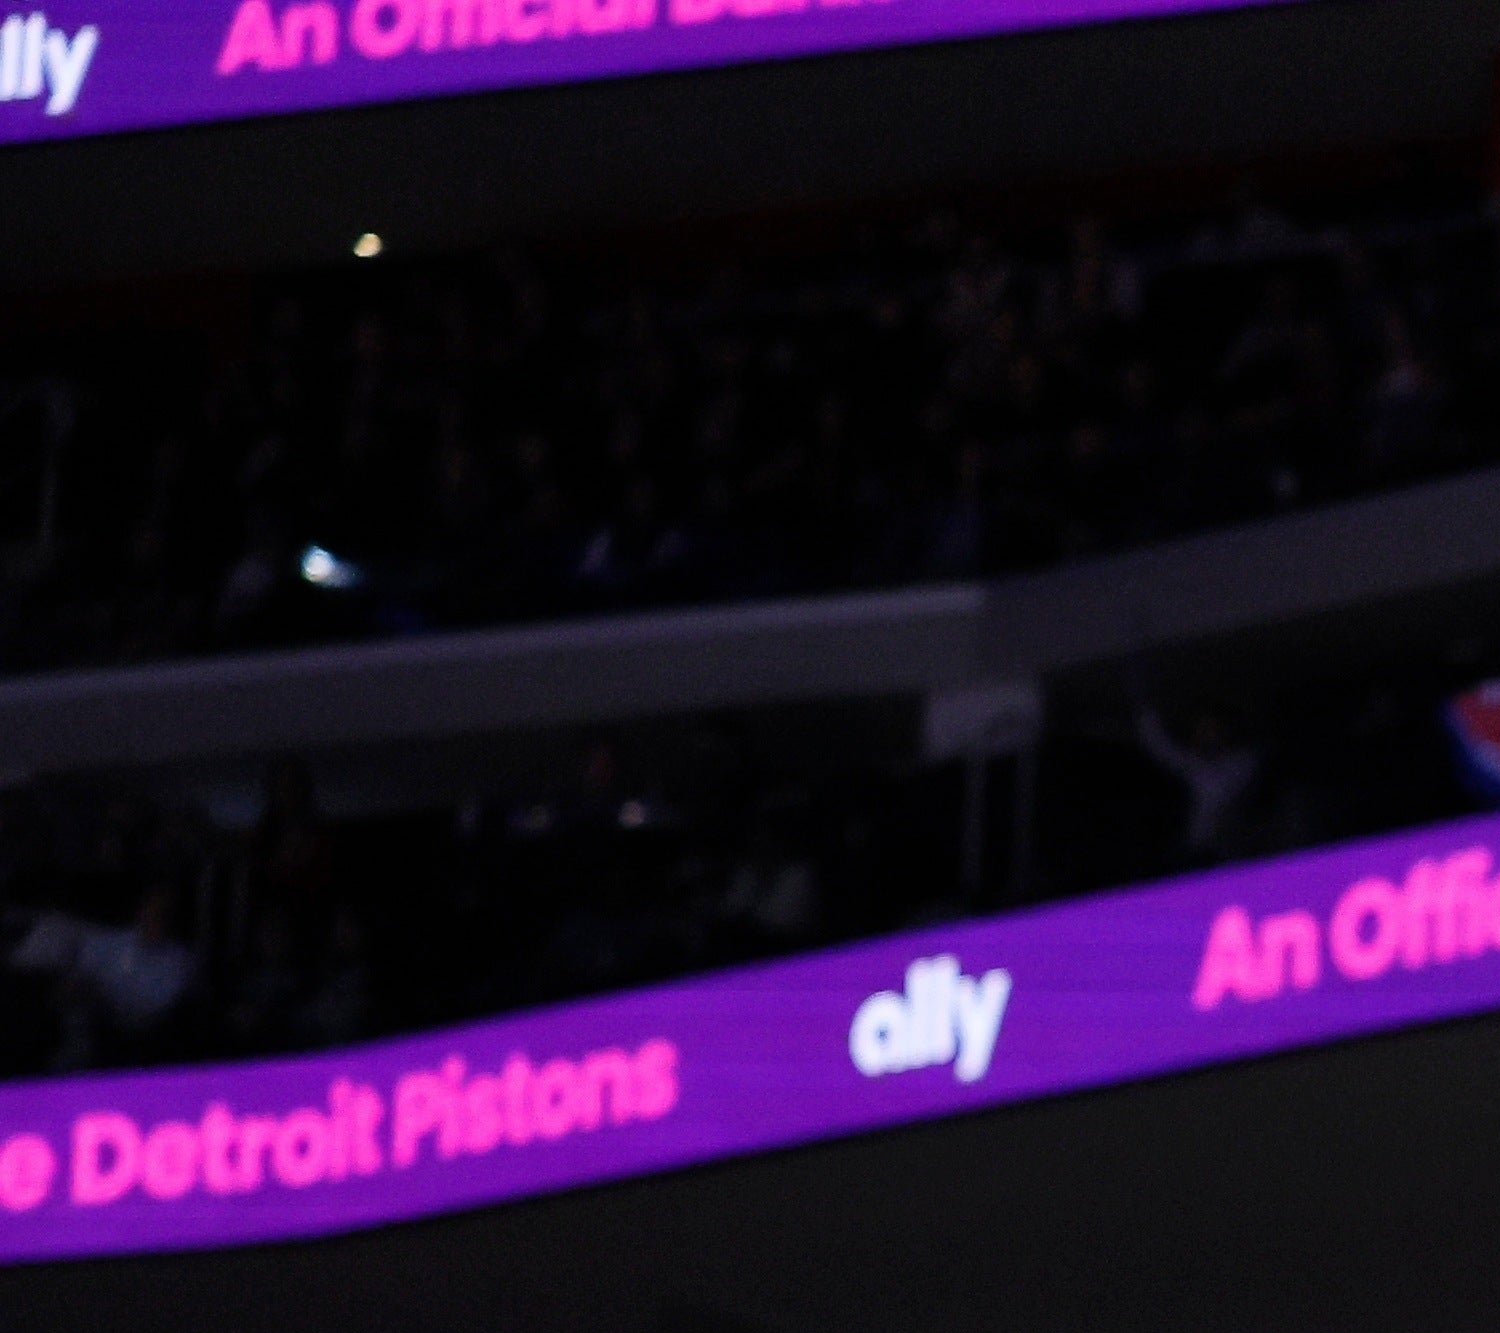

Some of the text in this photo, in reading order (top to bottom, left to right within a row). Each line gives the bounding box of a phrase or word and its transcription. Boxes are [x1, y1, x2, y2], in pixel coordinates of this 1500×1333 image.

[0, 12, 99, 115] lly
[216, 0, 339, 75] An
[1192, 905, 1322, 1011] An
[849, 953, 1011, 1082] ally
[69, 1077, 386, 1206] Detroit
[390, 1039, 680, 1168] Pistons
